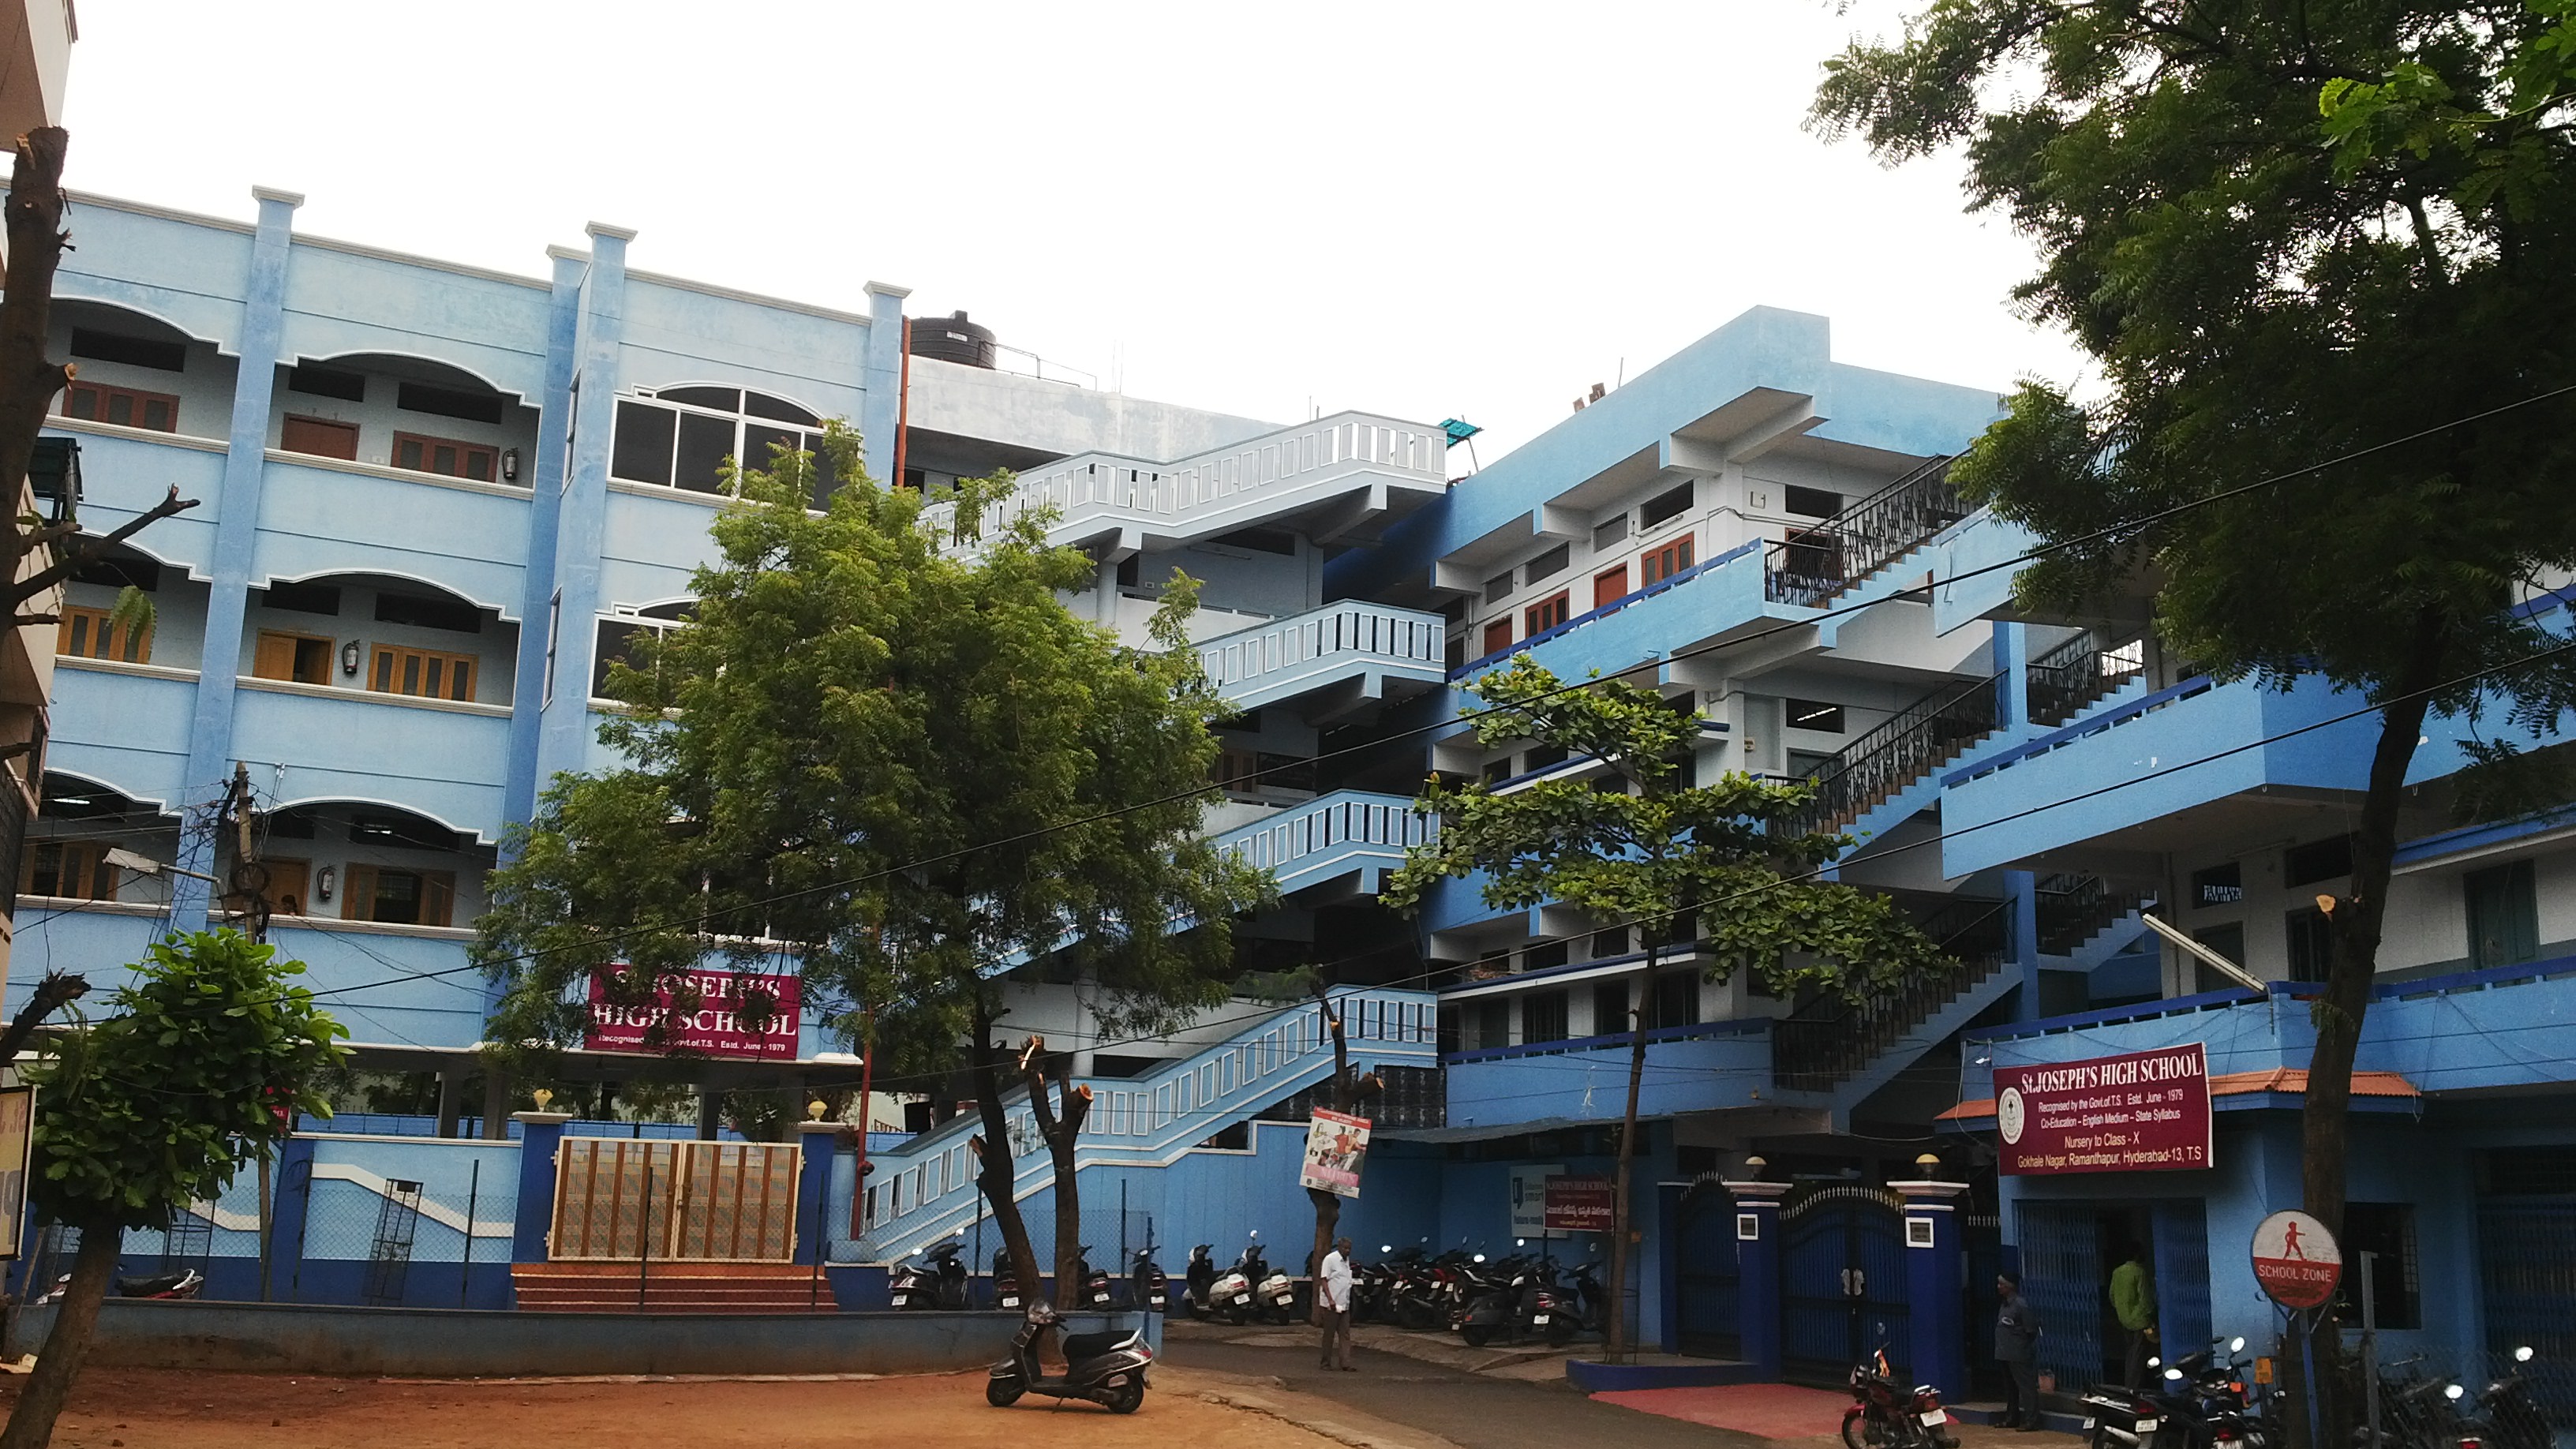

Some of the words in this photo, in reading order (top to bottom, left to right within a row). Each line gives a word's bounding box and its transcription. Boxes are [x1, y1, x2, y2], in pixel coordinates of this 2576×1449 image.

[743, 1042, 761, 1050] June
[768, 1043, 785, 1052] 1979
[2021, 1066, 2099, 1095] St.JOSEPH'S
[2100, 1061, 2138, 1086] HIGH
[2140, 1053, 2203, 1082] SCHOOL
[2039, 1100, 2070, 1114] Recognised
[2070, 1099, 2079, 1113] by
[2079, 1099, 2088, 1110] the
[2146, 1091, 2162, 1103] June
[2167, 1088, 2184, 1101] 1979
[2041, 1117, 2077, 1129] Co-Education
[2083, 1113, 2104, 1129] English
[2105, 1112, 2129, 1124] Medium
[2136, 1110, 2152, 1122] State
[2154, 1108, 2181, 1124] Syllabus
[2065, 1136, 2093, 1151] Nursery
[2094, 1134, 2102, 1147] to
[2104, 1132, 2126, 1147] Class
[2132, 1130, 2140, 1145] X
[2017, 1155, 2044, 1168] Gokhale
[2045, 1154, 2068, 1170] Nagar,
[2258, 1264, 2299, 1280] SCHOOL
[2302, 1268, 2332, 1282] ZONE
